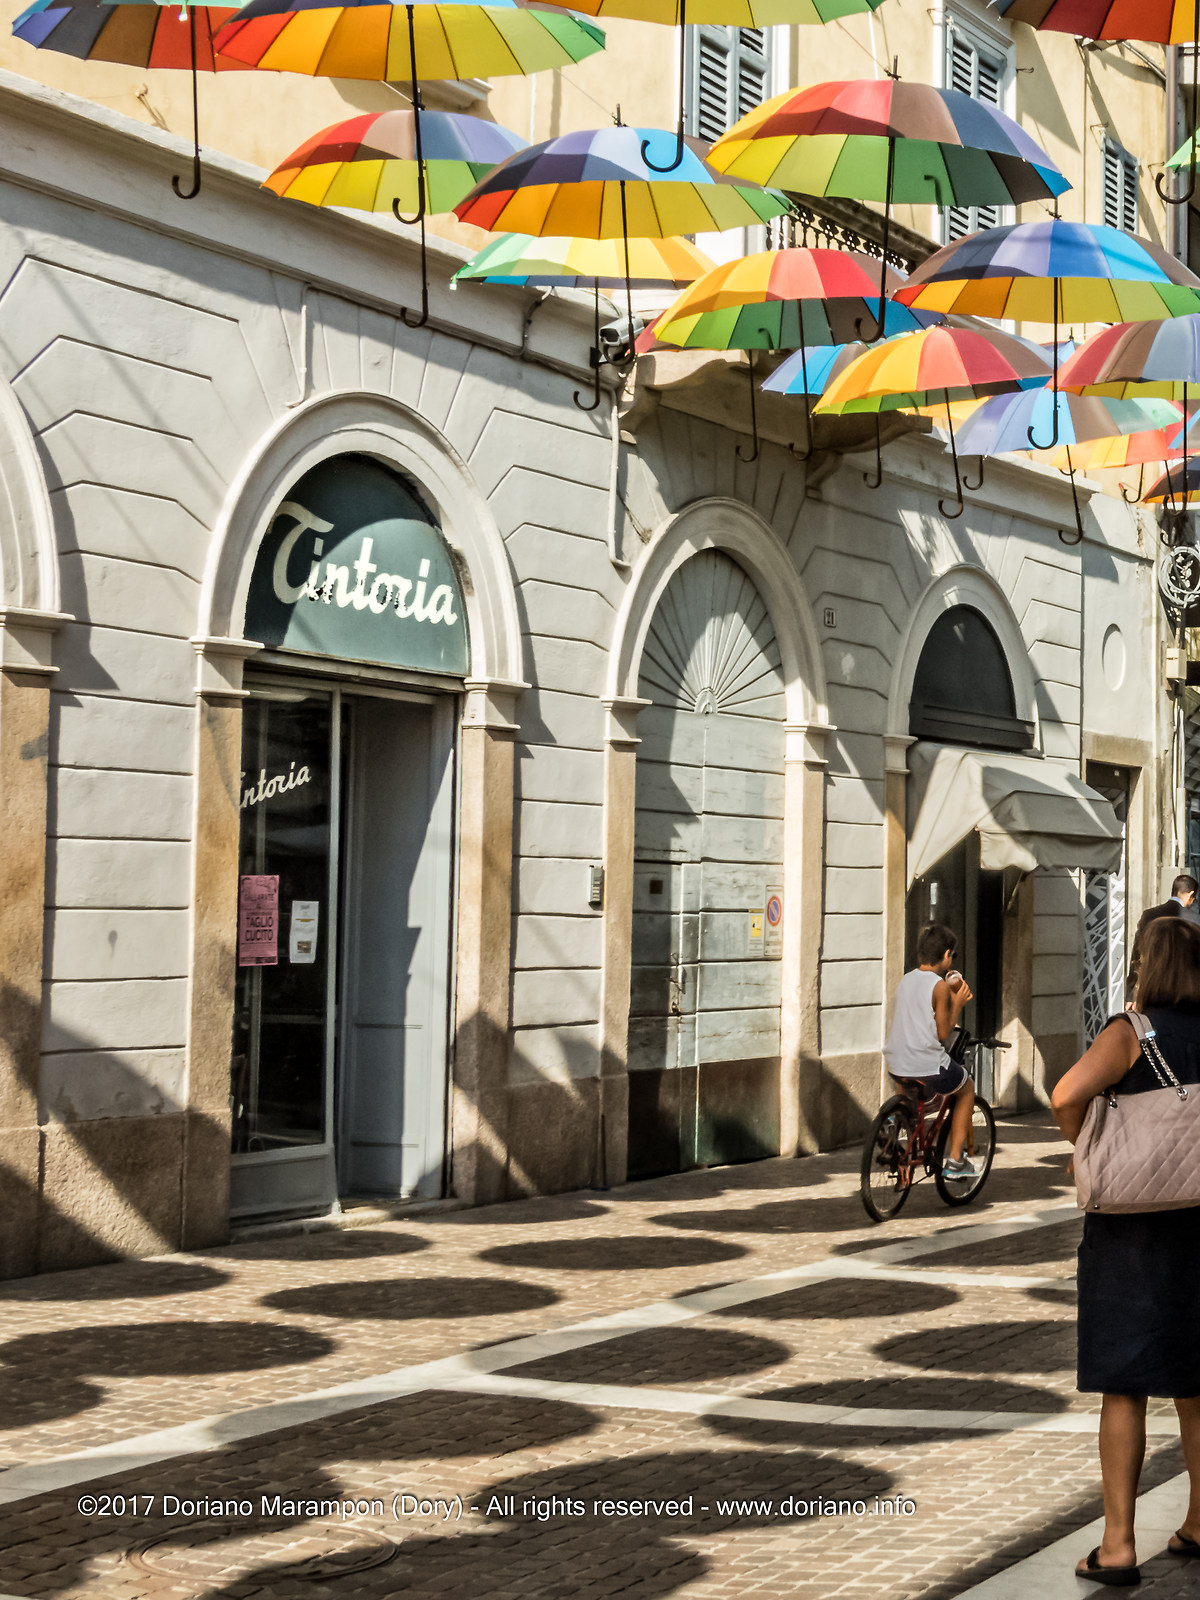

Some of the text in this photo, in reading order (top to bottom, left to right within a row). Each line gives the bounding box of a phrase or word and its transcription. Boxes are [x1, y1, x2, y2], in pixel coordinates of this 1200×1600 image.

[267, 501, 458, 626] Tintoria
[246, 916, 274, 928] TAGLIO
[245, 929, 274, 942] CUCITO
